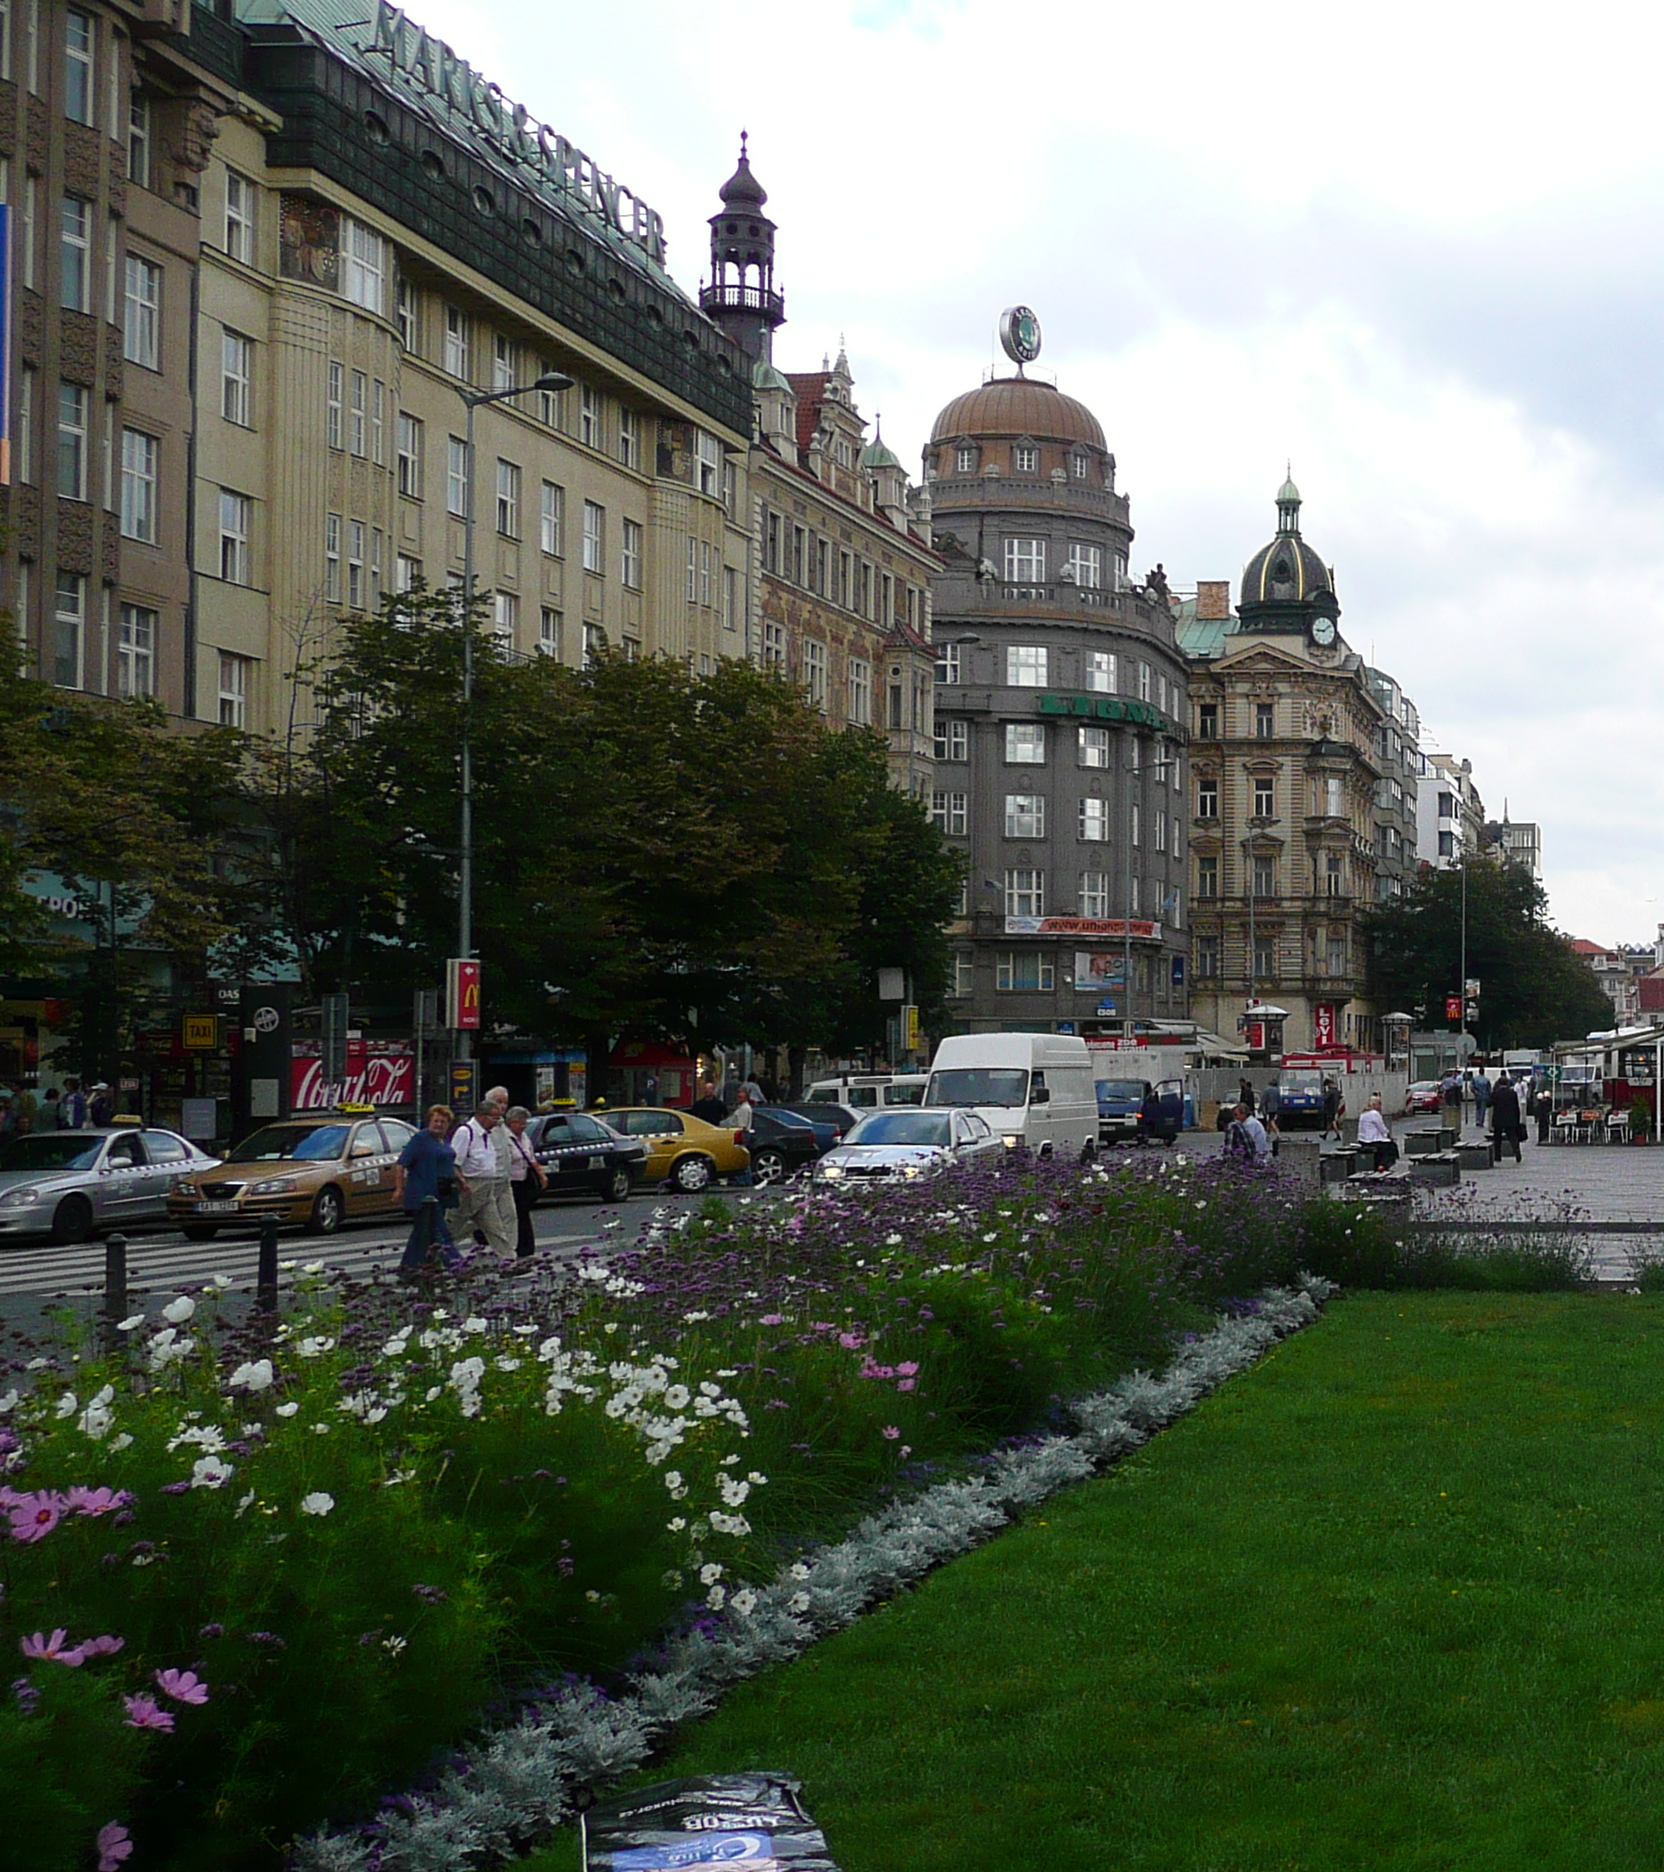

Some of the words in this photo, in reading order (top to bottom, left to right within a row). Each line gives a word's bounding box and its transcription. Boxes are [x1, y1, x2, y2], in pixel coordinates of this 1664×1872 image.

[371, 0, 502, 139] MARKS
[511, 103, 527, 157] &
[537, 124, 665, 265] SPENCER
[189, 1024, 212, 1038] TAXI
